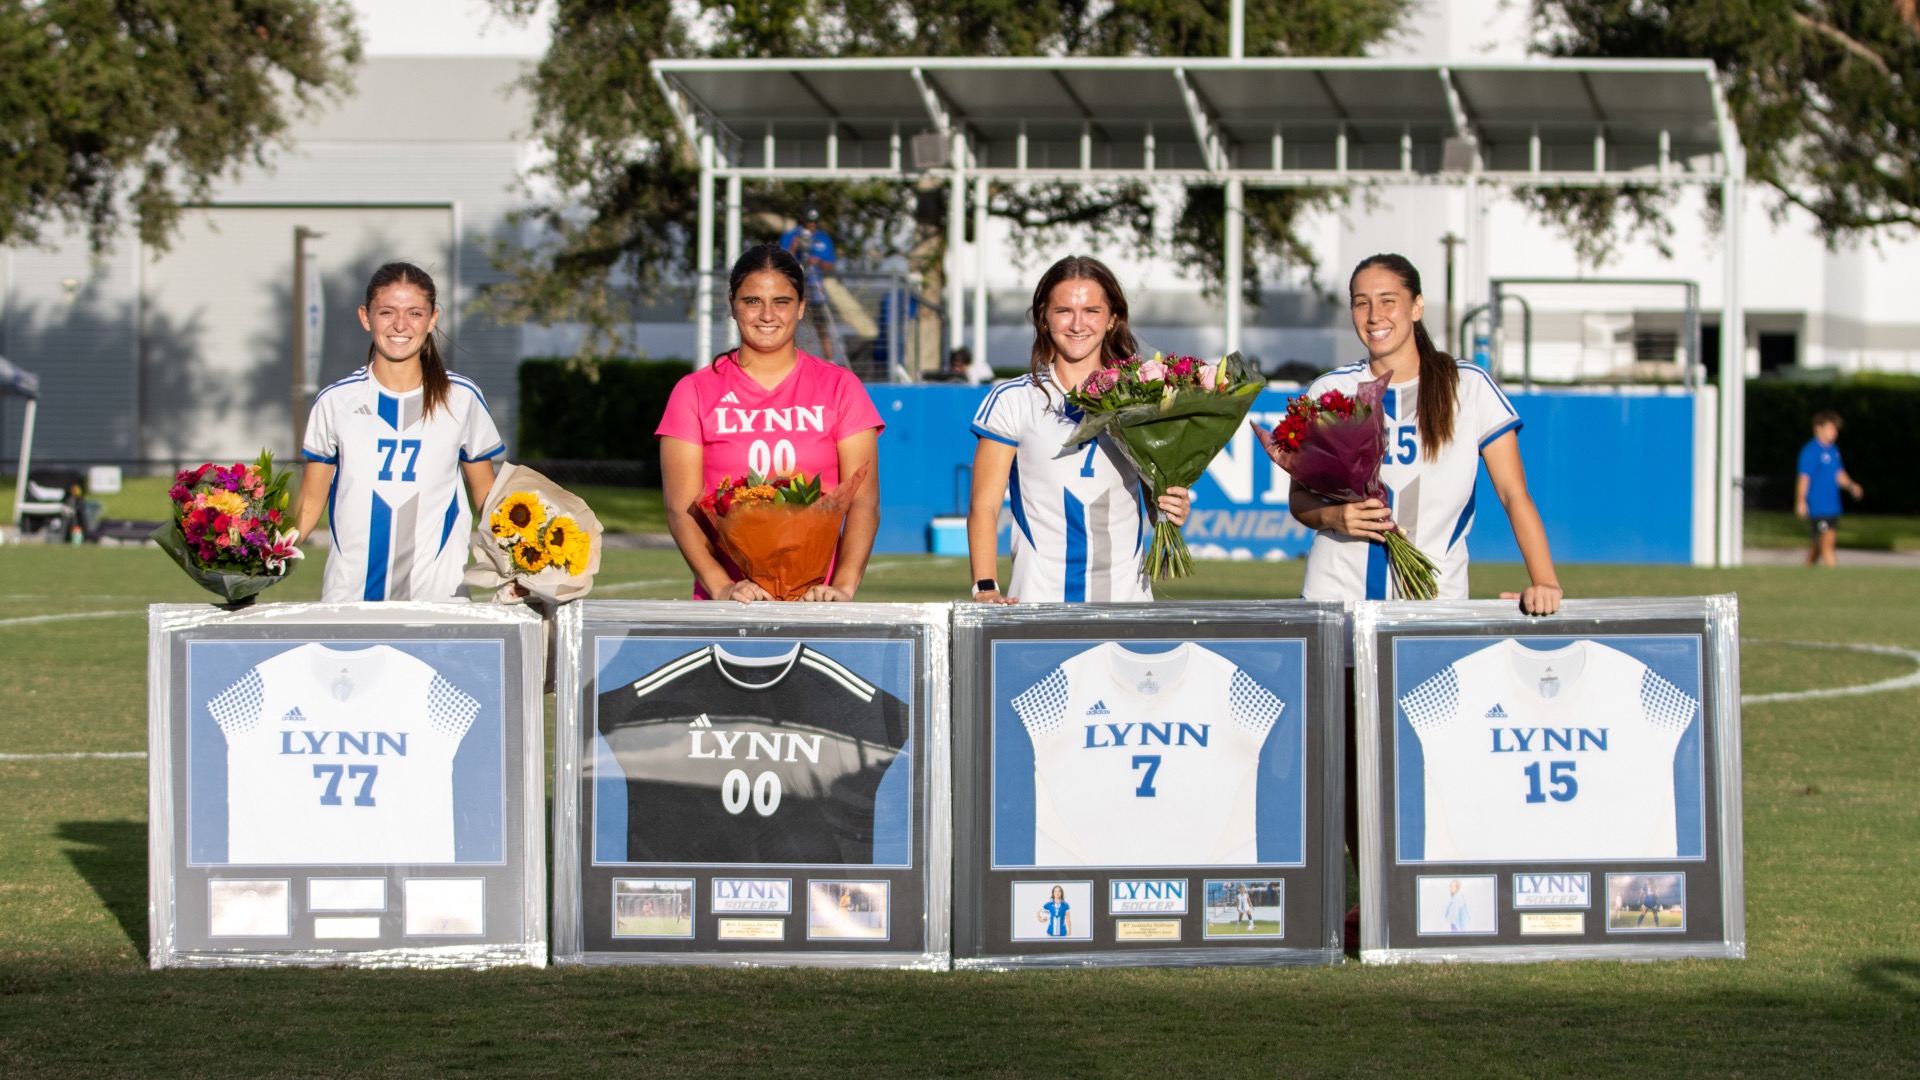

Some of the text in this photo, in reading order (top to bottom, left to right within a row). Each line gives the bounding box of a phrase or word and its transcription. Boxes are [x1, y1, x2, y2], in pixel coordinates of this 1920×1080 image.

[714, 405, 826, 435] LYNN
[376, 438, 422, 482] 77
[747, 438, 796, 480] 00
[1078, 439, 1097, 477] 7
[1186, 510, 1304, 537] KNIGH
[279, 731, 409, 756] LYNN
[687, 730, 824, 764] LYNN
[1082, 721, 1212, 749] LYNN
[1490, 728, 1610, 753] LYNN
[312, 764, 379, 808] 77
[1131, 754, 1162, 798] 7
[1524, 760, 1578, 803] 15
[721, 768, 782, 818] 00
[717, 880, 787, 898] LYNN
[1114, 881, 1184, 899] LYNN
[1517, 875, 1586, 893] LYNN
[723, 900, 779, 910] SOCCER
[1121, 901, 1175, 911] SOCCER
[1524, 895, 1578, 905] SOCCER
